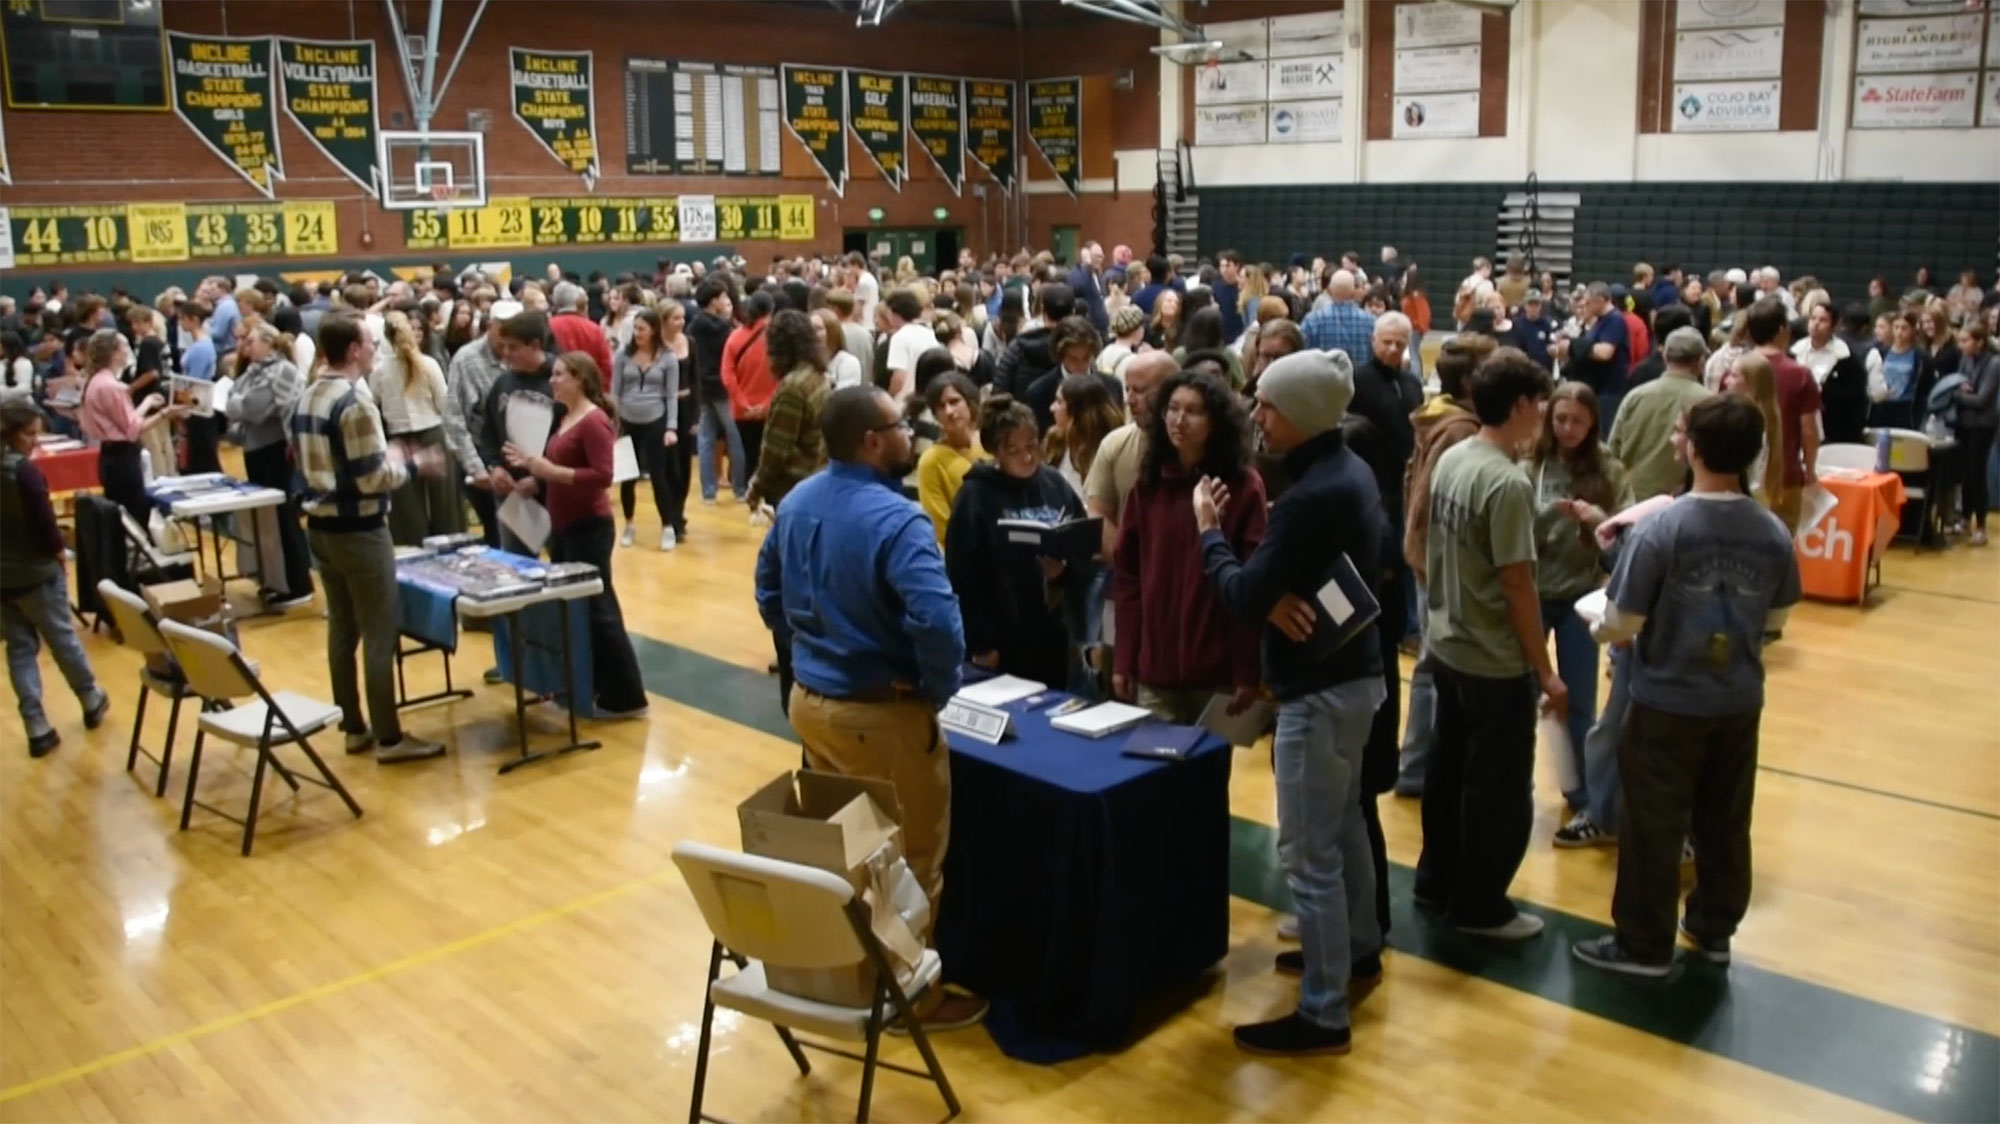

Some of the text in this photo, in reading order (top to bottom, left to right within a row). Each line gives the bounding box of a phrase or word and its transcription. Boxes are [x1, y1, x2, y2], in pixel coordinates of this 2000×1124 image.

[190, 43, 250, 61] INCLINE
[294, 43, 359, 64] INCLINE
[176, 59, 266, 77] BASKETBALL
[283, 61, 373, 82] VOLLEYBALL
[525, 54, 578, 72] INCLINE
[203, 78, 245, 92] STATE
[515, 69, 588, 89] BASKETBALL
[793, 70, 834, 86] INCLINE
[859, 76, 893, 92] INCLINE
[185, 91, 262, 107] CHAMPIONS
[308, 83, 351, 98] STATE
[534, 89, 571, 104] STATE
[865, 90, 888, 106] GOLF
[912, 91, 957, 108] BASEBALL
[1749, 91, 1771, 103] BAY
[292, 98, 369, 113] CHAMPIONS
[520, 102, 586, 118] CHAMPIONS
[802, 105, 827, 118] STATE
[1707, 104, 1772, 117] ADVISORS
[792, 118, 840, 133] CHAMPIONS
[855, 117, 899, 132] CHAMPIONS
[412, 208, 441, 238] 55
[460, 209, 479, 235] 11
[500, 208, 523, 234] 23
[538, 207, 564, 234] 23
[579, 207, 602, 233] 10
[618, 206, 637, 232] 11
[652, 206, 675, 231] 55
[721, 205, 743, 231] 30
[757, 205, 772, 229] 11
[788, 205, 805, 228] 44
[23, 217, 61, 252] 44
[84, 216, 118, 250] 10
[195, 214, 228, 245] 43
[246, 213, 278, 244] 35
[296, 213, 324, 242] 24
[1794, 516, 1854, 562] ch
